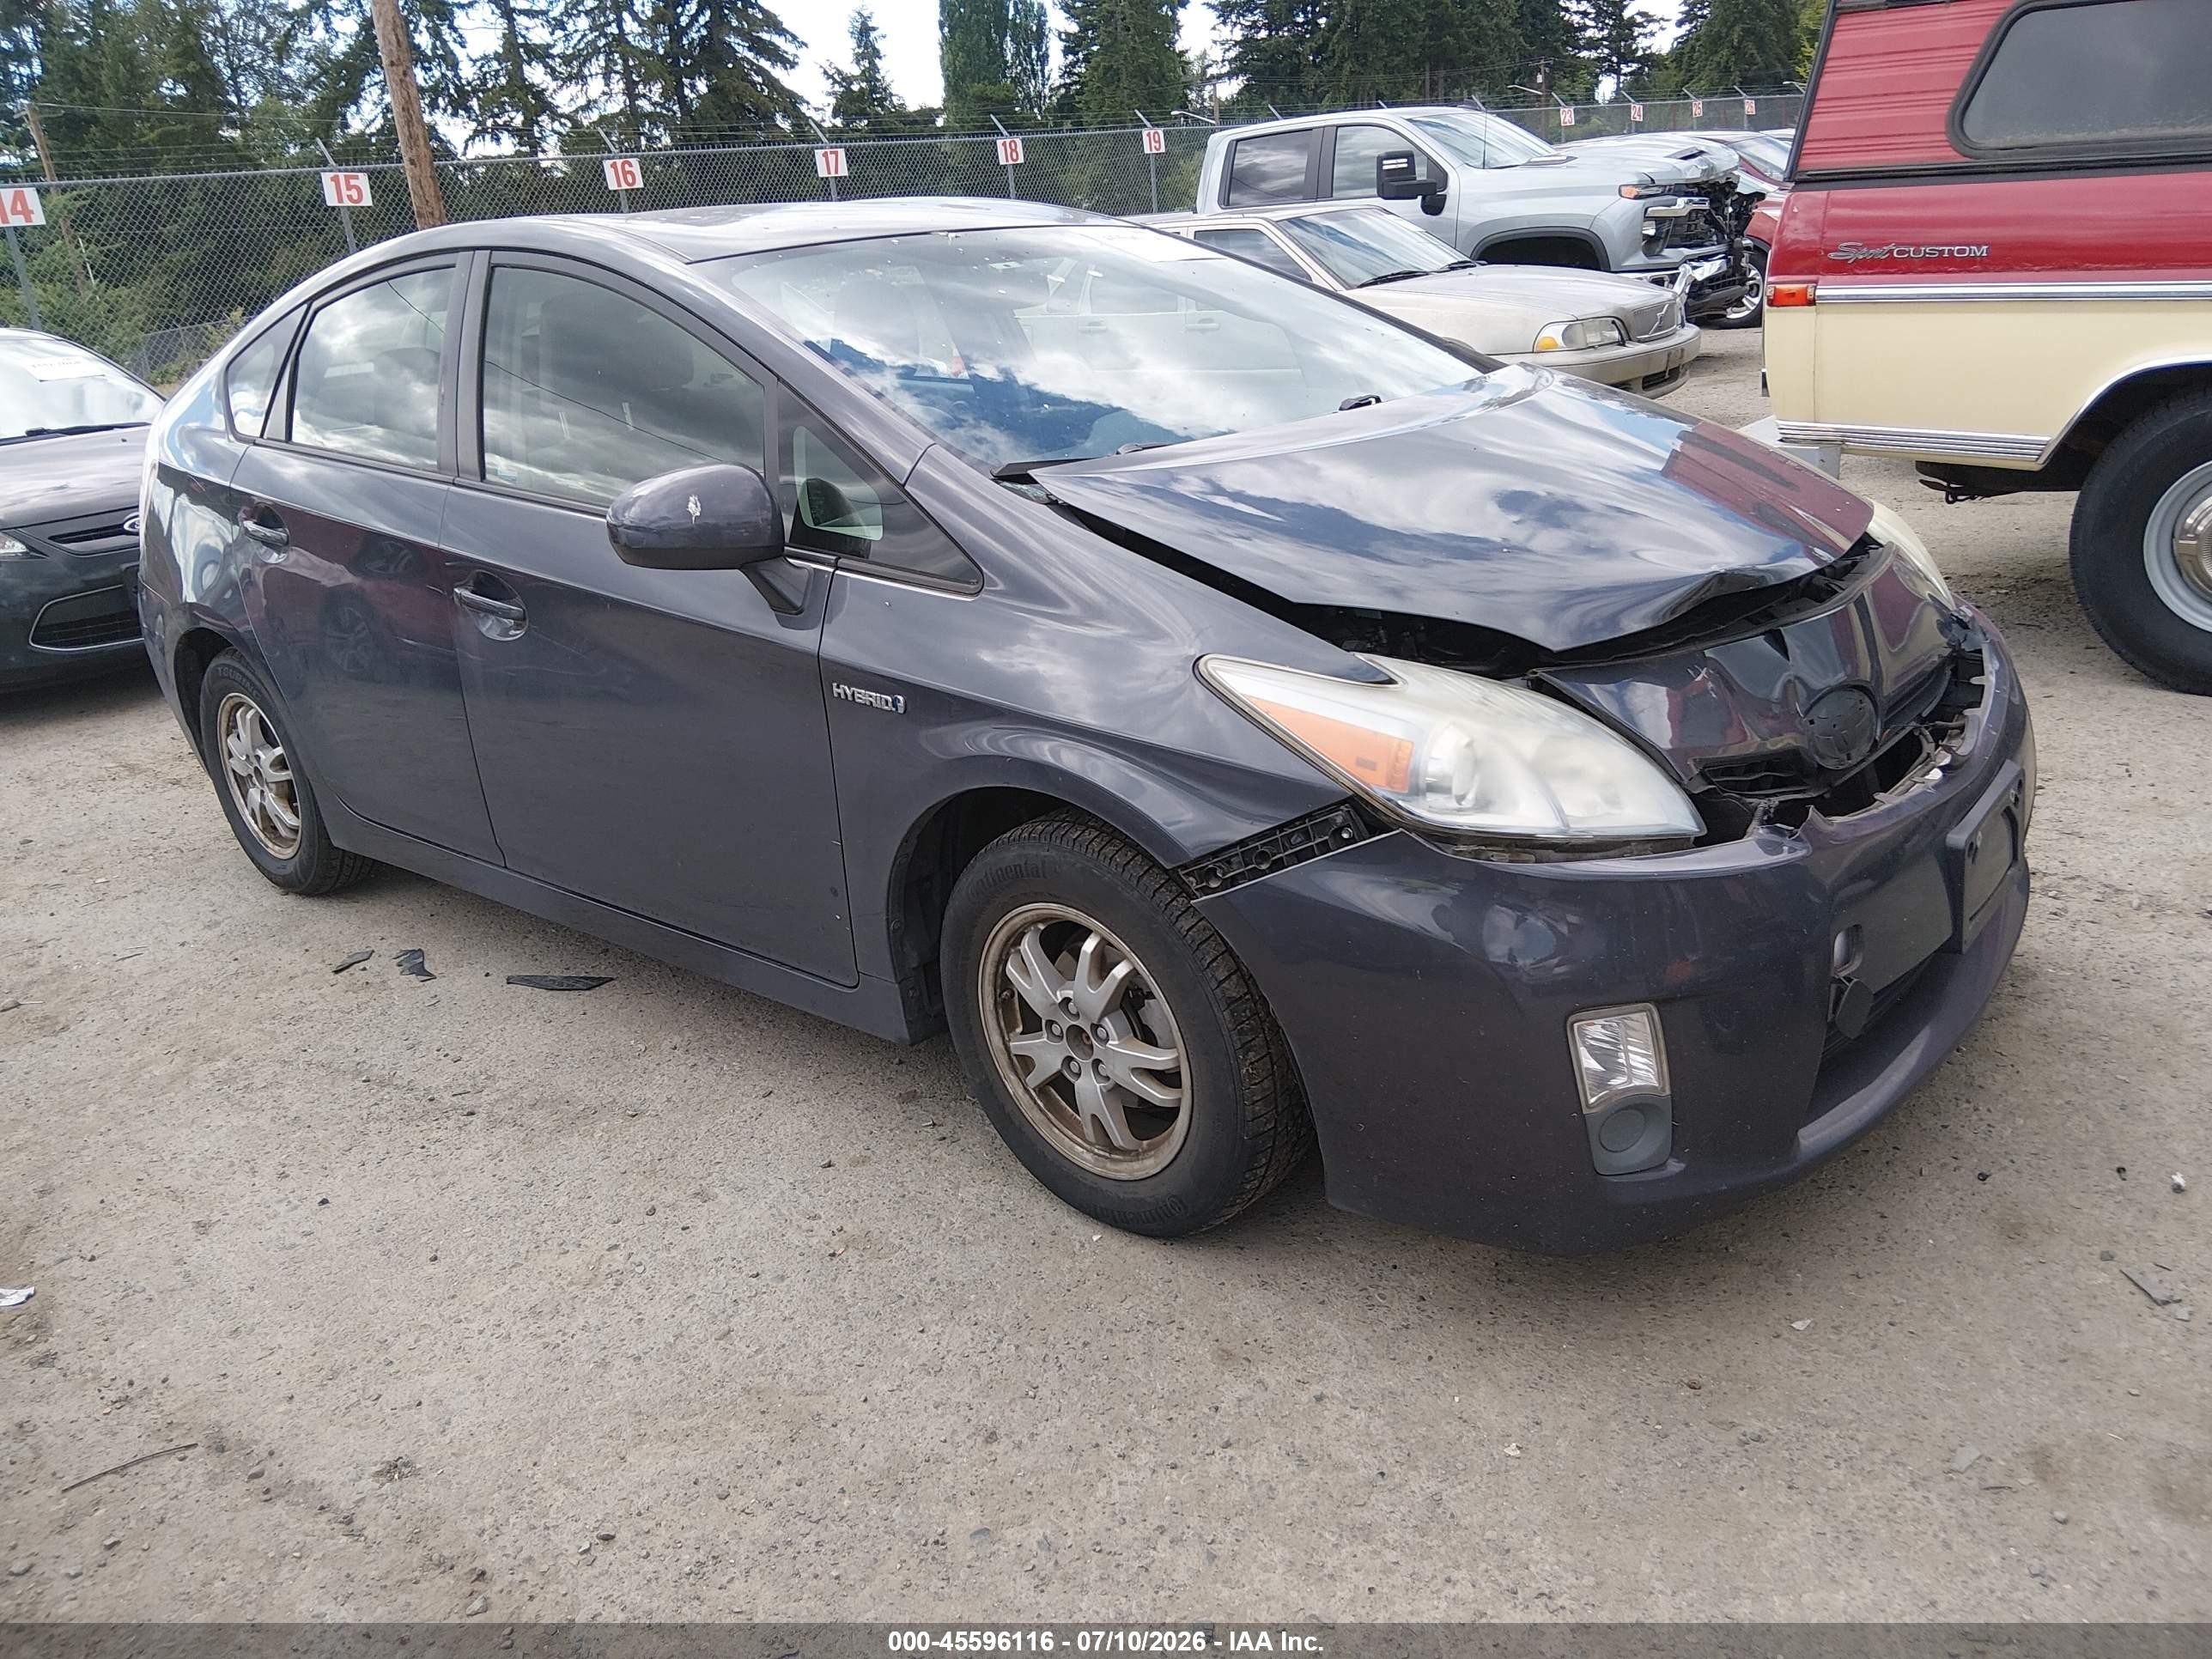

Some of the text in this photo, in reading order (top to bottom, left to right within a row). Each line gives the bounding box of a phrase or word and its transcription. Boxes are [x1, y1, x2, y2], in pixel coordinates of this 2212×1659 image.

[1562, 109, 1573, 125] 23
[1632, 106, 1642, 120] 24
[1001, 140, 1019, 163] 18
[1146, 131, 1162, 152] 19
[822, 150, 839, 174] 17
[610, 160, 636, 188] 16
[330, 174, 363, 204] 15
[1827, 241, 1989, 264] Sport CUSTOM
[217, 666, 262, 701] TOURING
[832, 683, 893, 711] HYBRID
